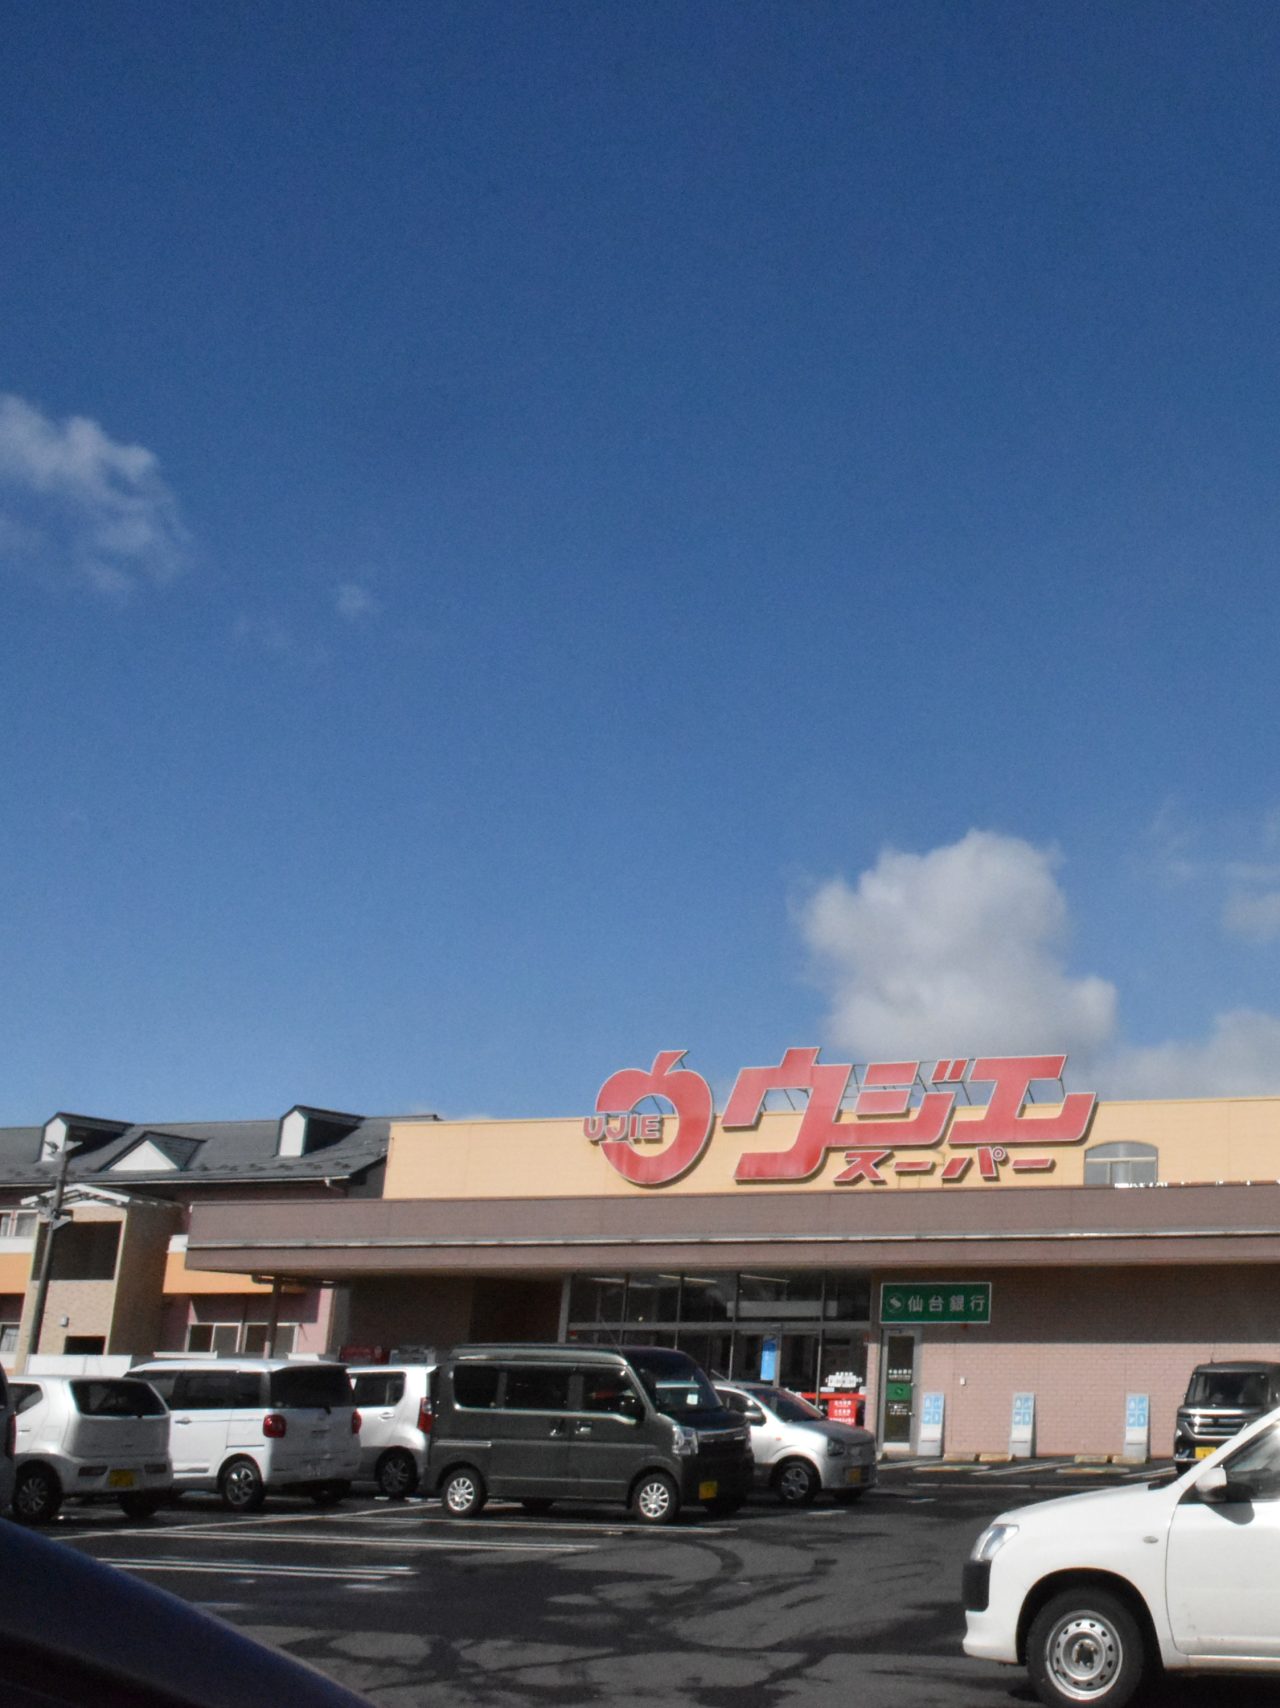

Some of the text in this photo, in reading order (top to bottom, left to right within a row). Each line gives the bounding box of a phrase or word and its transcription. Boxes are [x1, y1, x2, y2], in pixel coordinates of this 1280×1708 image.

[583, 1113, 661, 1141] UJIE
[722, 1046, 1097, 1181] ウジエ
[834, 1146, 1055, 1184] スーパー
[907, 1294, 986, 1312] 仙台銀行
